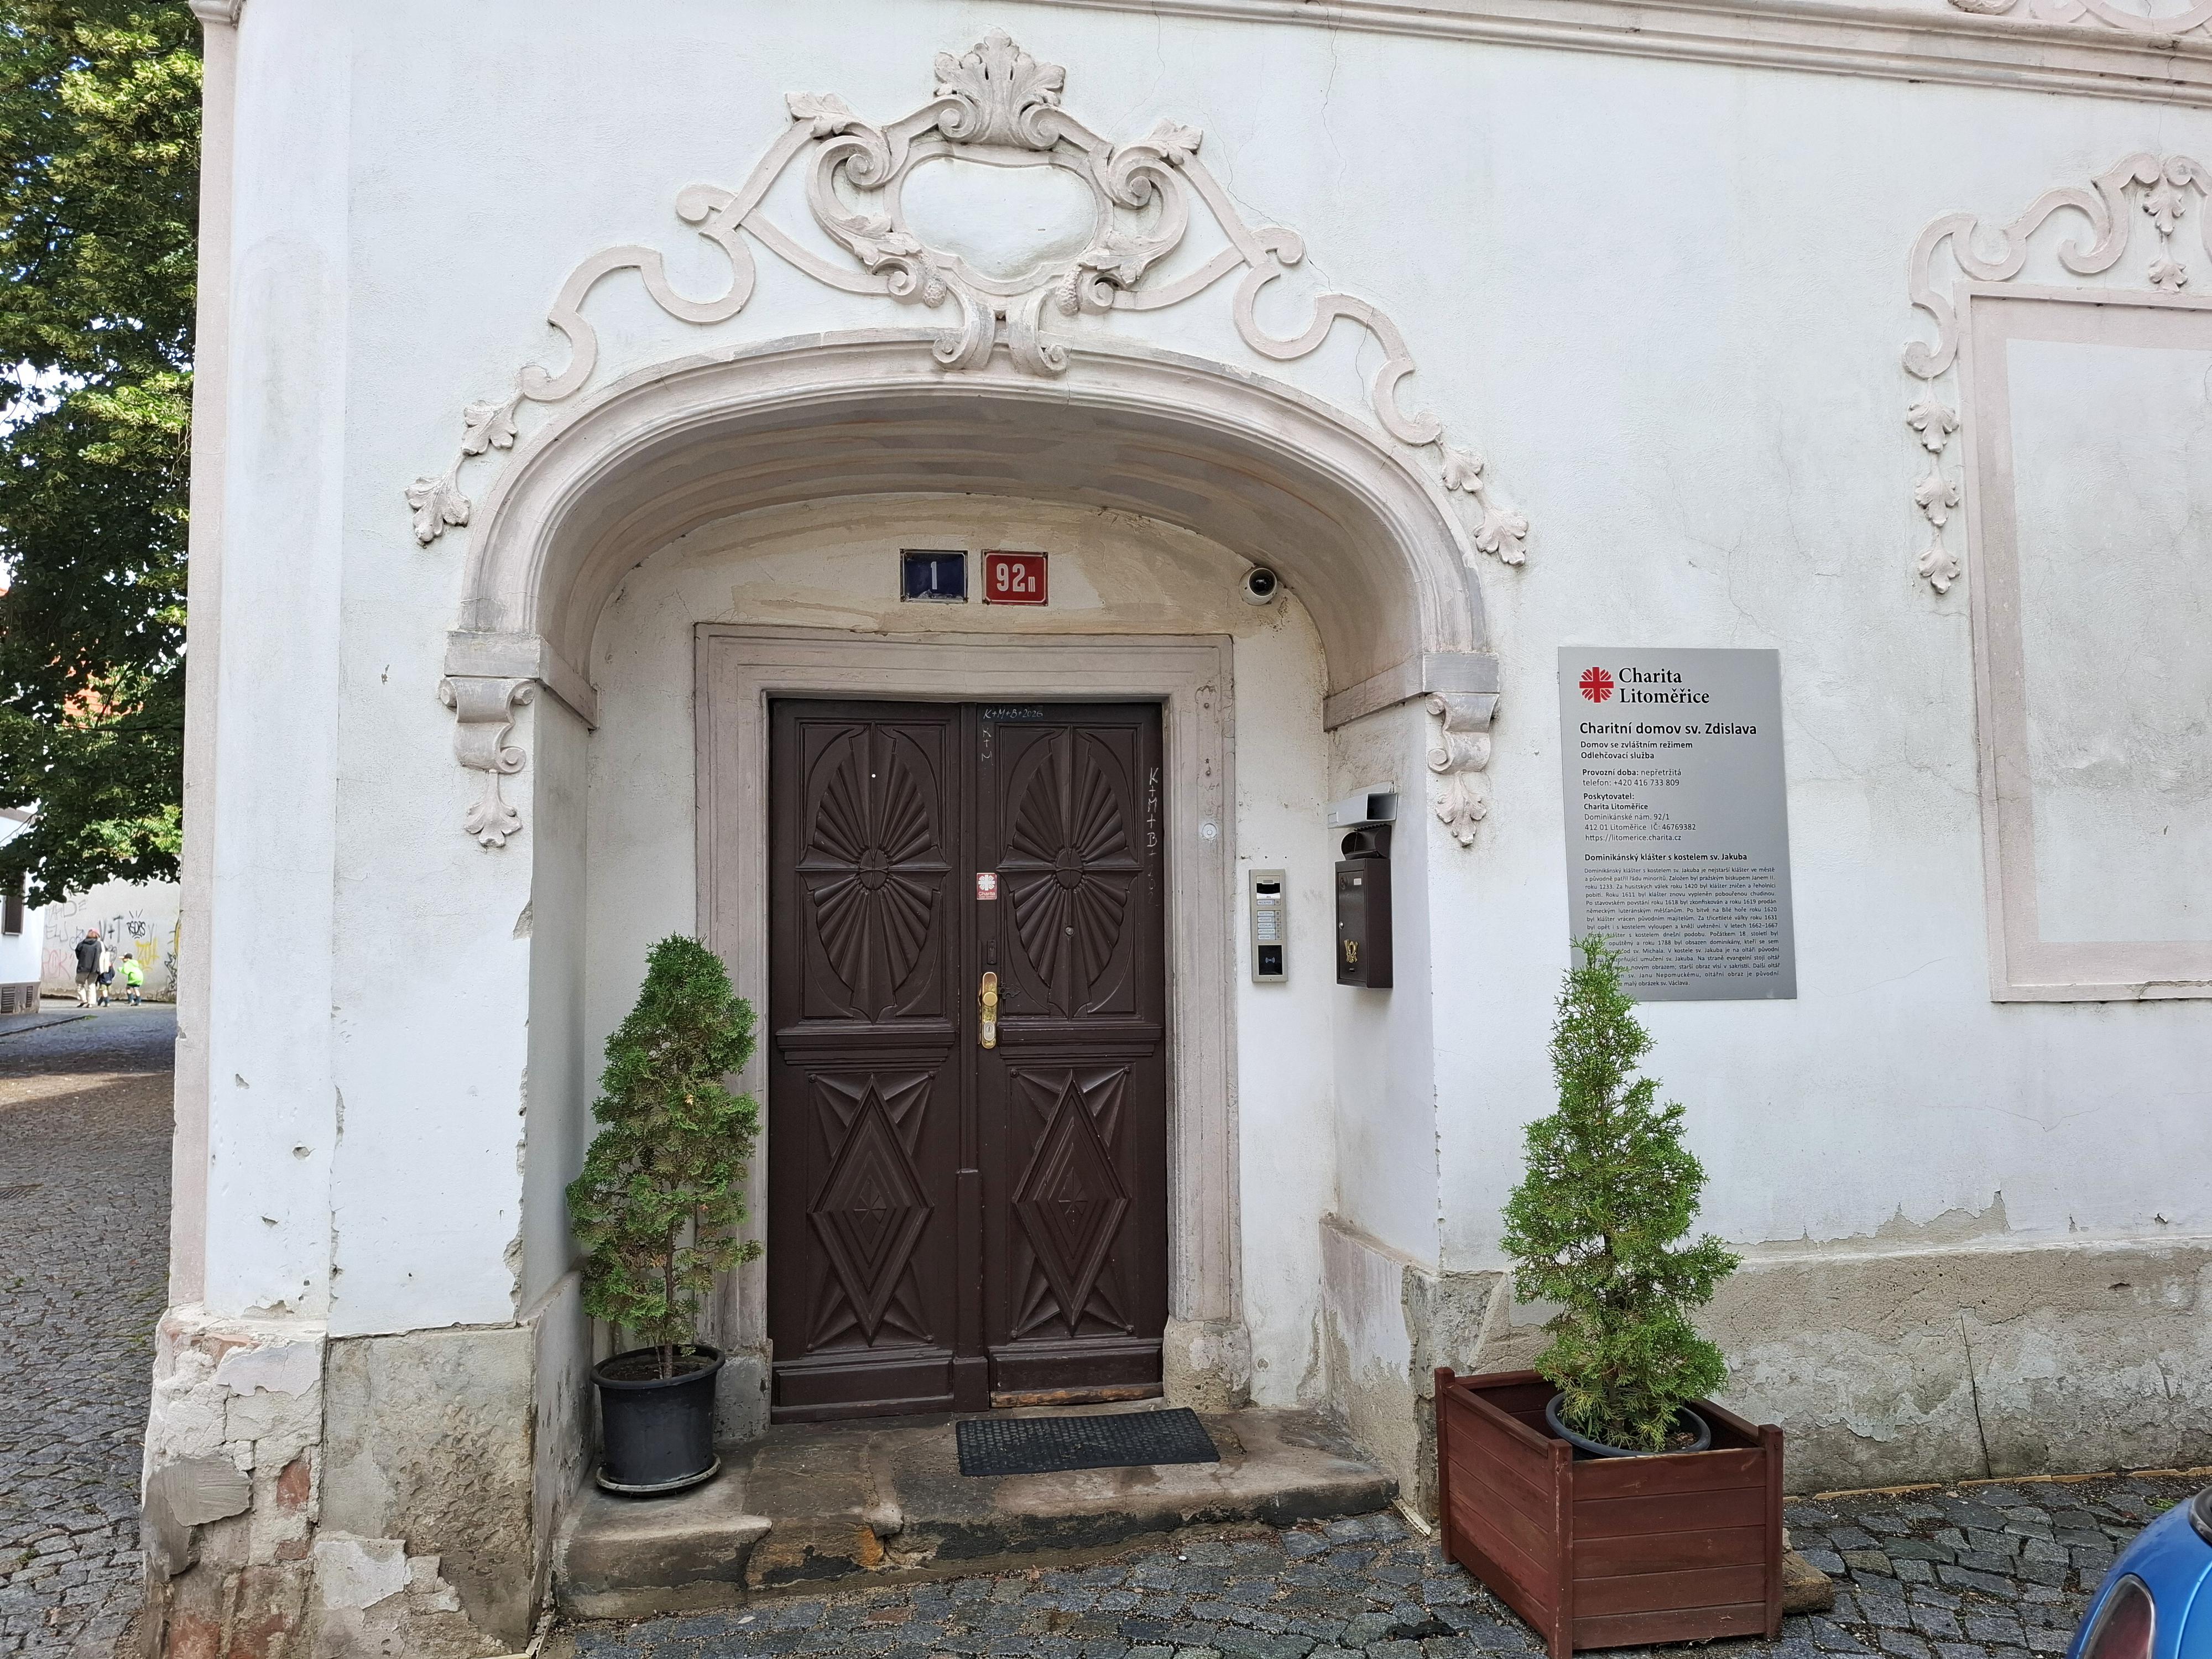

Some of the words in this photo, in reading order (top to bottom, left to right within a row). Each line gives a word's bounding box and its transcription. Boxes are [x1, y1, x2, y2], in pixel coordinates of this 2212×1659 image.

[930, 561, 937, 589] 1
[1619, 667, 1682, 683] Charita
[1619, 688, 1709, 703] Litoměřice
[1580, 722, 1631, 734] Charitní
[1636, 722, 1681, 734] domov
[1685, 726, 1701, 734] sv.
[1705, 722, 1756, 734] Zdislava
[1641, 769, 1681, 777] nepřetržitá
[1583, 792, 1635, 801] Poskytovatel:
